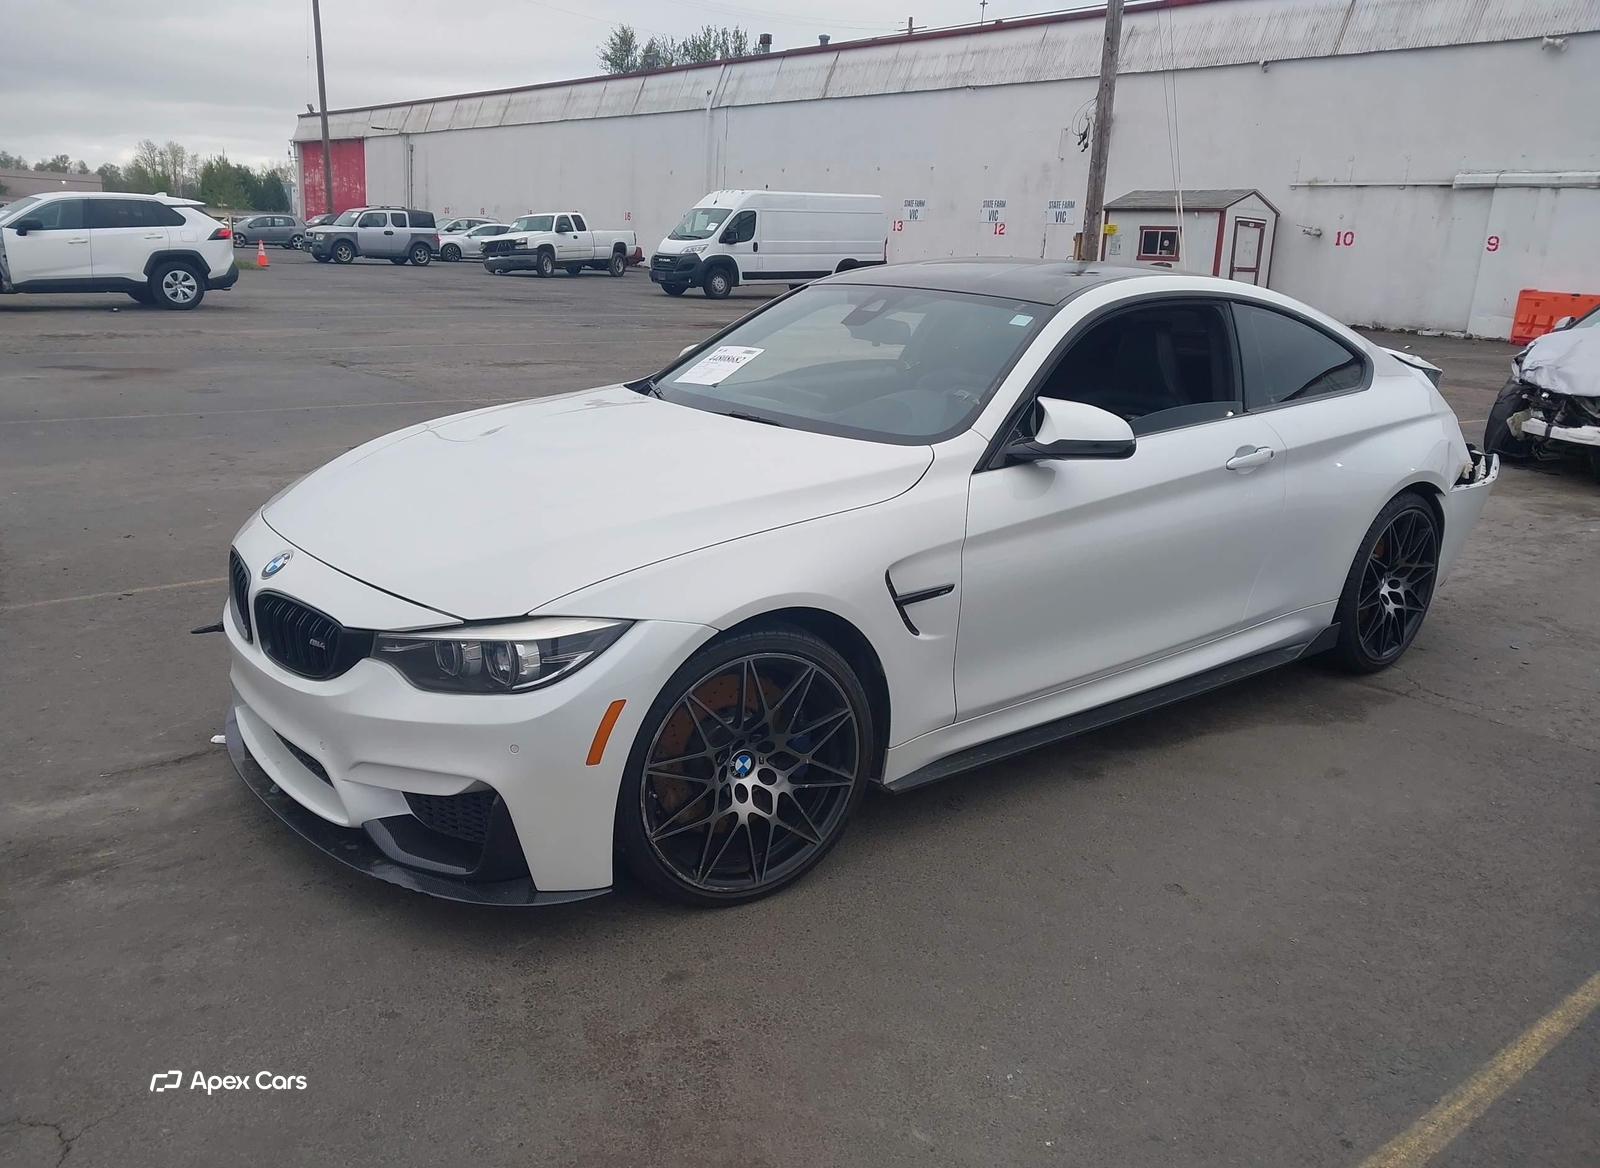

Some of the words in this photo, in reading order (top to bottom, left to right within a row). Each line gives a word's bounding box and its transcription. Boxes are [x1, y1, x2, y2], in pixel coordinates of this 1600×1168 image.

[904, 200, 914, 208] STATE
[915, 200, 926, 208] FARM
[982, 200, 994, 208] STATE
[994, 200, 1006, 208] FARM
[1048, 201, 1062, 209] STATE
[1062, 201, 1075, 209] FARM
[909, 209, 919, 220] VIC
[988, 210, 999, 222] VIC
[1055, 211, 1067, 223] VIC
[892, 220, 903, 232] 13
[993, 223, 1006, 235] 12
[1335, 231, 1355, 247] 10
[1487, 235, 1500, 252] 9
